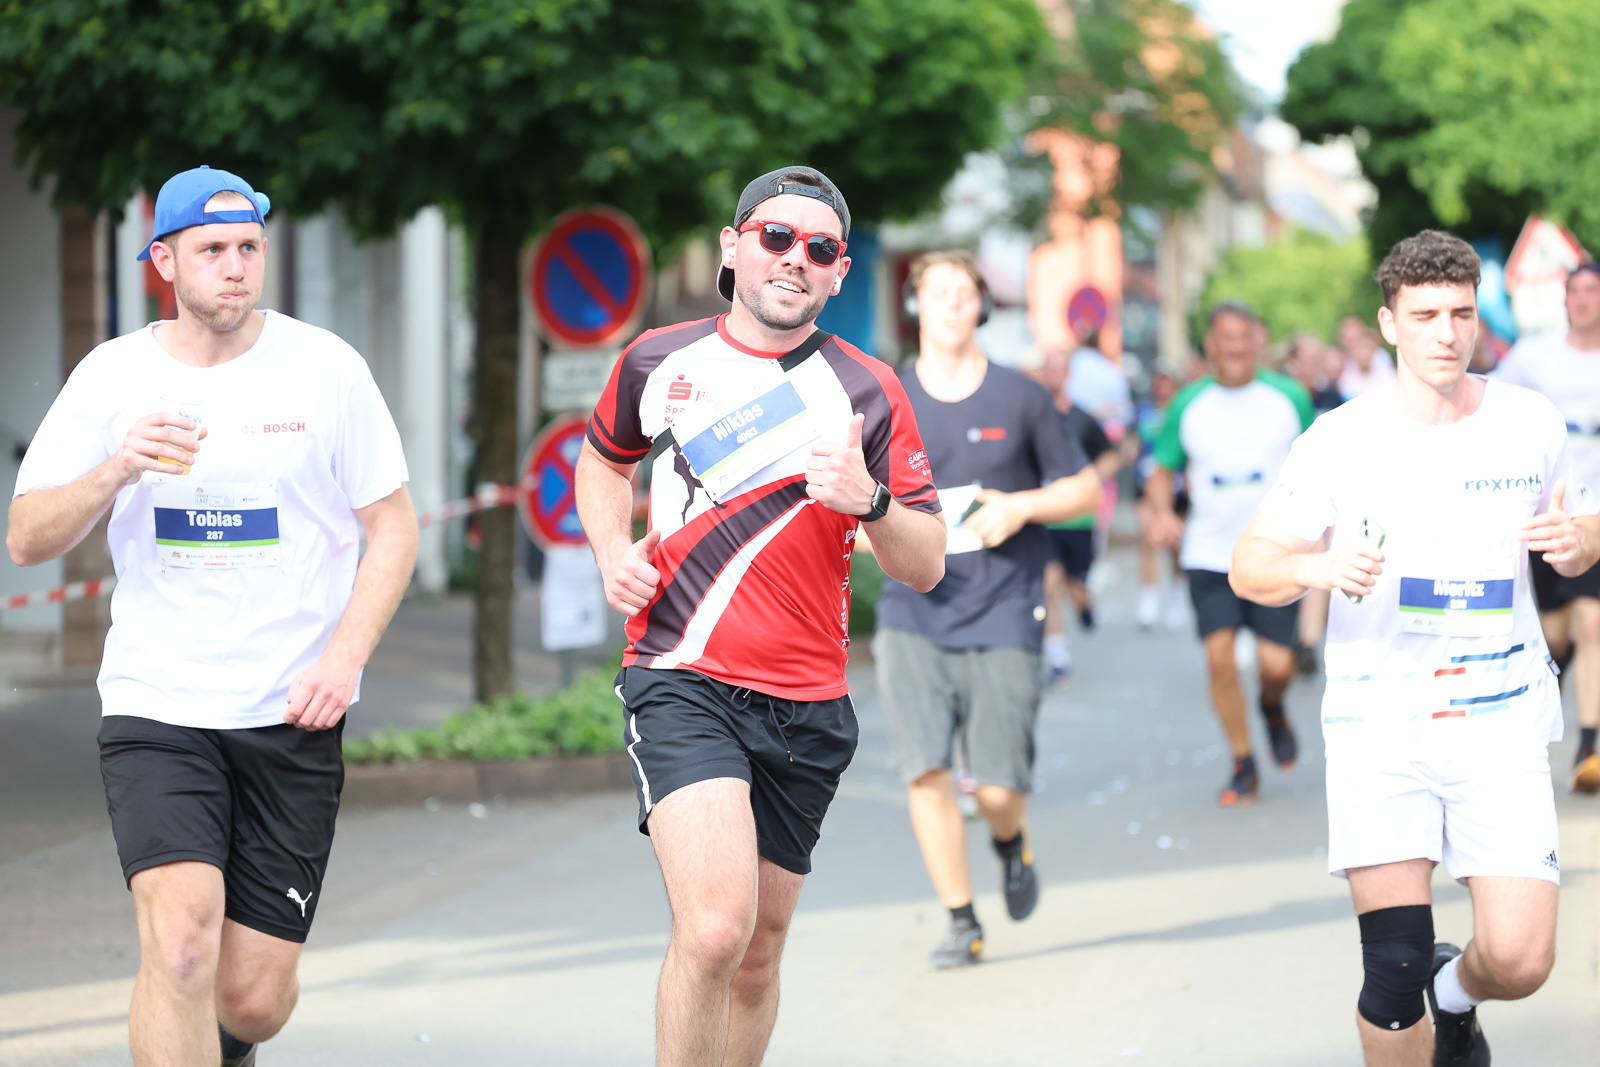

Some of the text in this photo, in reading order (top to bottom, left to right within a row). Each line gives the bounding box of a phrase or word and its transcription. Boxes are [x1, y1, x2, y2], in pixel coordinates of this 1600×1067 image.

[263, 422, 306, 433] BOSCH
[711, 403, 764, 441] Niklas
[1464, 474, 1543, 495] rexroth
[186, 510, 243, 527] Tobias
[206, 531, 224, 540] 287
[1433, 580, 1485, 597] Moritz
